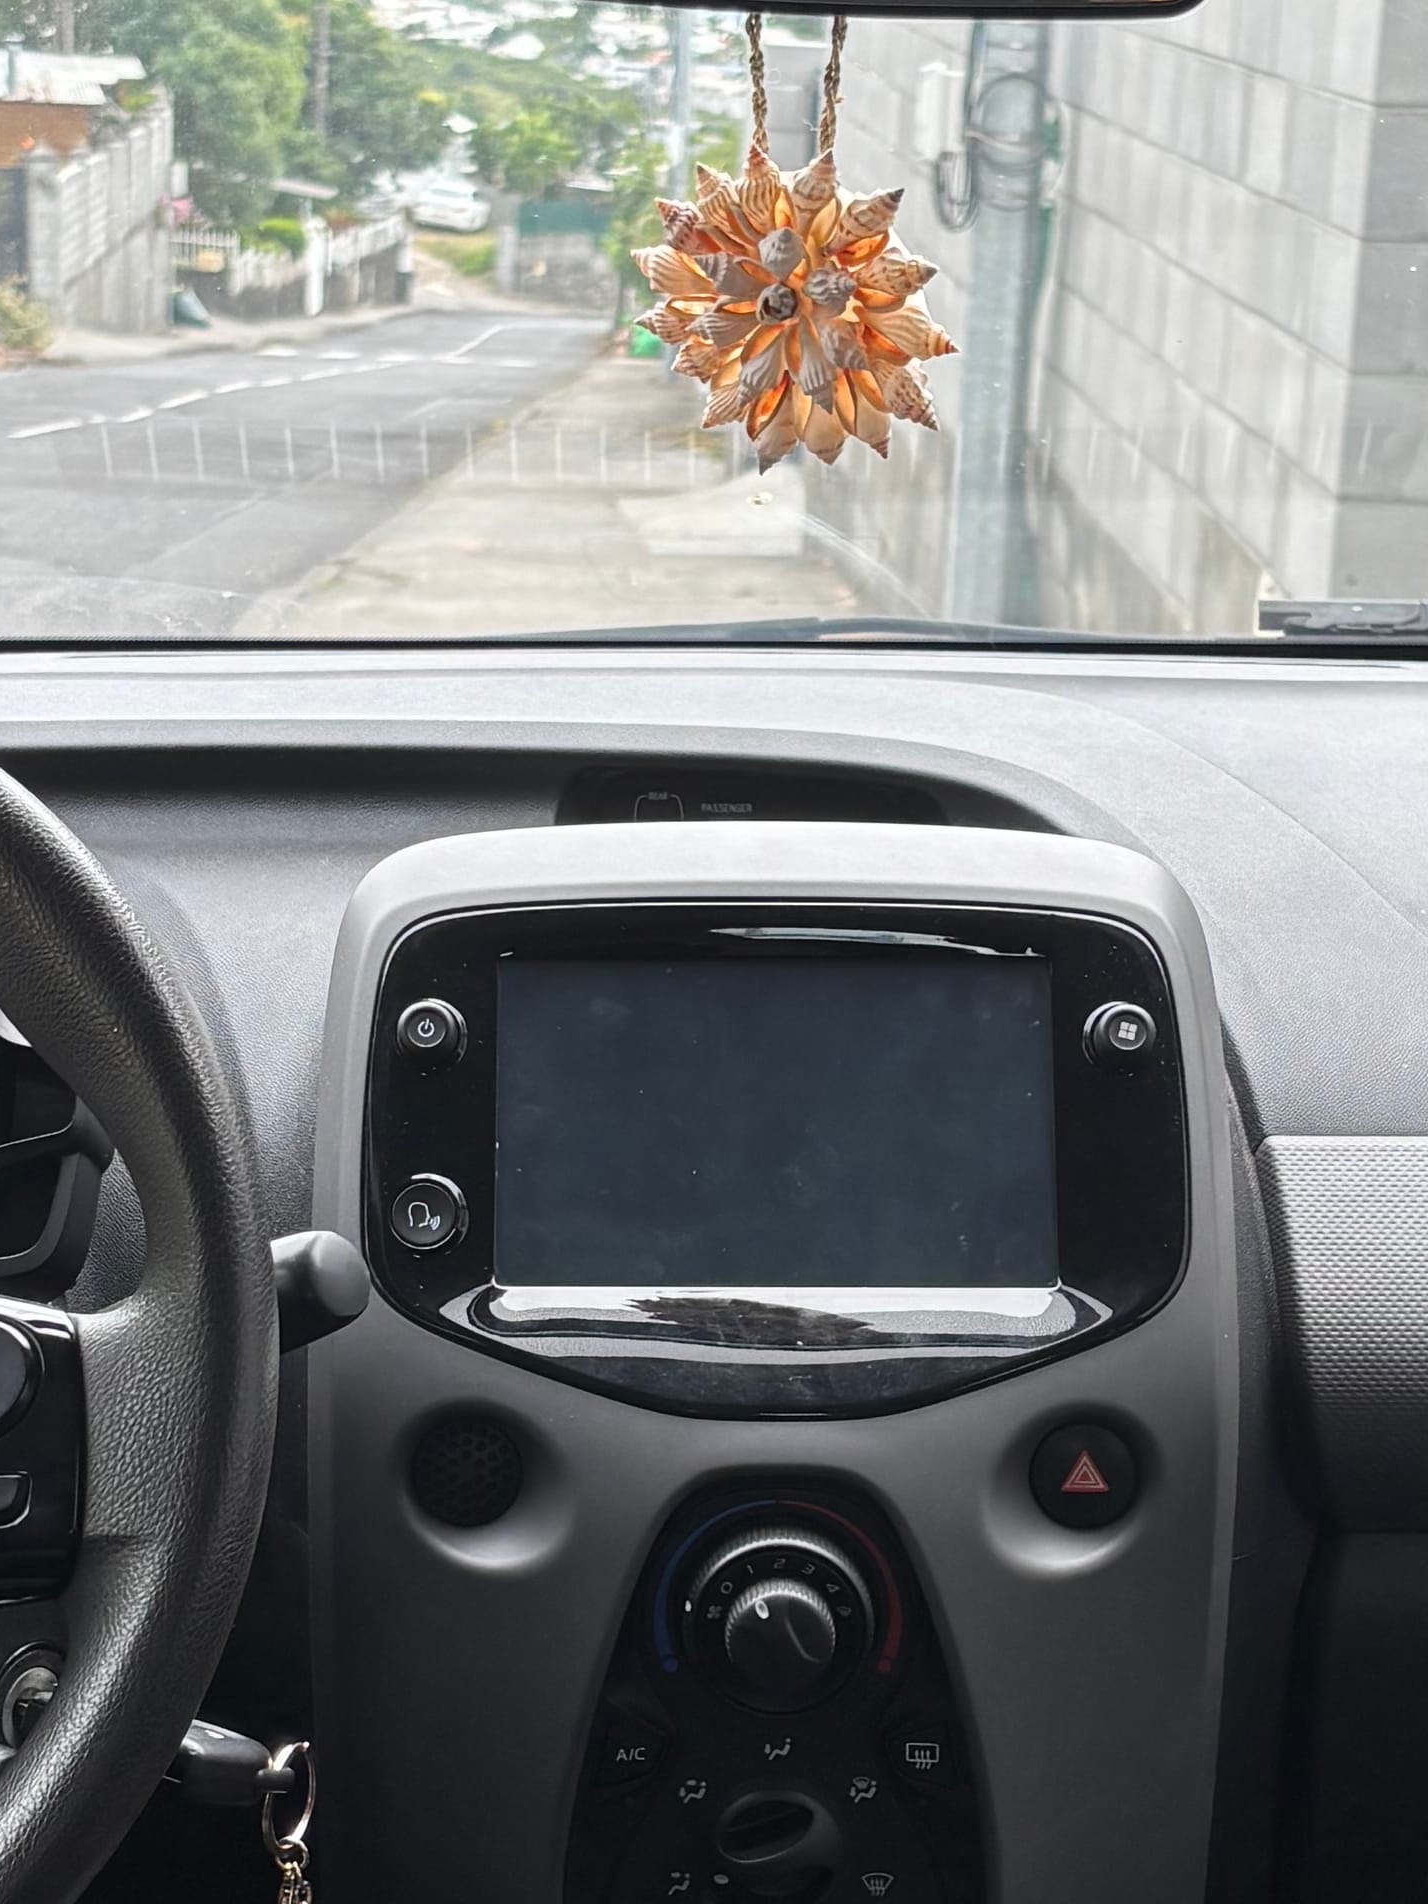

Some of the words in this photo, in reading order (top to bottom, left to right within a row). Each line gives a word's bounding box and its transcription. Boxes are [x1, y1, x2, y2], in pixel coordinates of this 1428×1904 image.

[773, 1558, 786, 1569] 2
[801, 1563, 815, 1575] 3
[826, 1583, 840, 1593] 4
[616, 1747, 645, 1761] A/C
